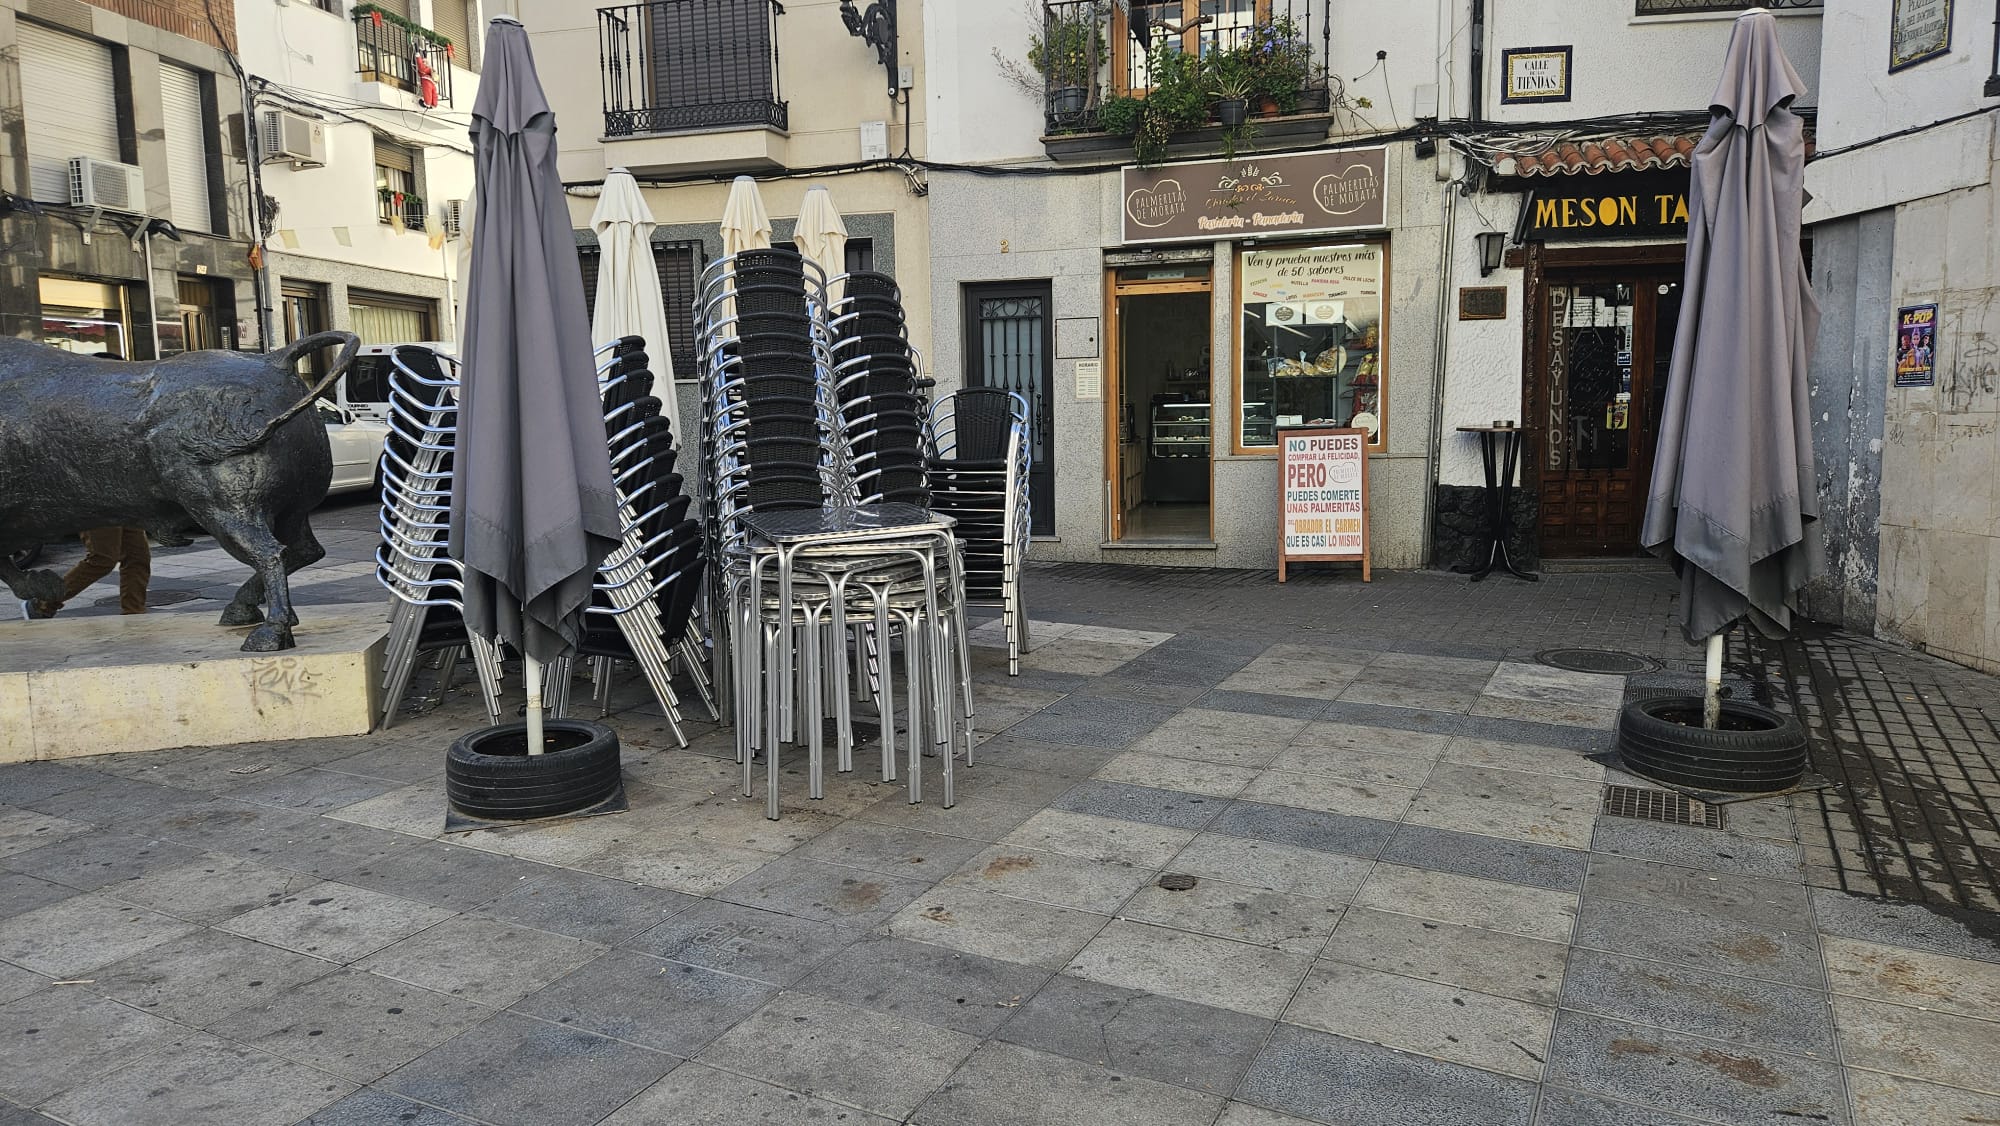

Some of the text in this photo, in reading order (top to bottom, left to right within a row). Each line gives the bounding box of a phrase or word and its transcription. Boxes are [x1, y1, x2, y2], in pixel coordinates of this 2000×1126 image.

[1524, 60, 1549, 71] CALLE
[1516, 75, 1557, 90] TIENDAS
[1323, 175, 1379, 196] PALMERITAS
[1135, 190, 1187, 209] PALMERITAS
[1324, 188, 1377, 207] DE MORATA
[1136, 202, 1185, 220] DE MORATA
[1534, 196, 1637, 229] MESON
[1000, 239, 1009, 253] 2
[1248, 250, 1376, 269] Ven y prueba nuestros más
[1277, 265, 1345, 276] de 50 sabores
[1904, 312, 1933, 325] K-POP
[1549, 290, 1565, 467] DESAYUNOS
[1289, 438, 1358, 452] NO PUEDES
[1288, 453, 1317, 461] COMPRAR
[1288, 463, 1327, 488] PERO
[1287, 490, 1360, 501] PUEDES COMERTE
[1287, 502, 1360, 513] UNAS PALMERITAS
[1295, 519, 1323, 533] OBRADOR
[1326, 519, 1332, 533] EL
[1335, 518, 1361, 533] CARMEN
[1286, 534, 1361, 547] QUE ES CASI LO MISMO
